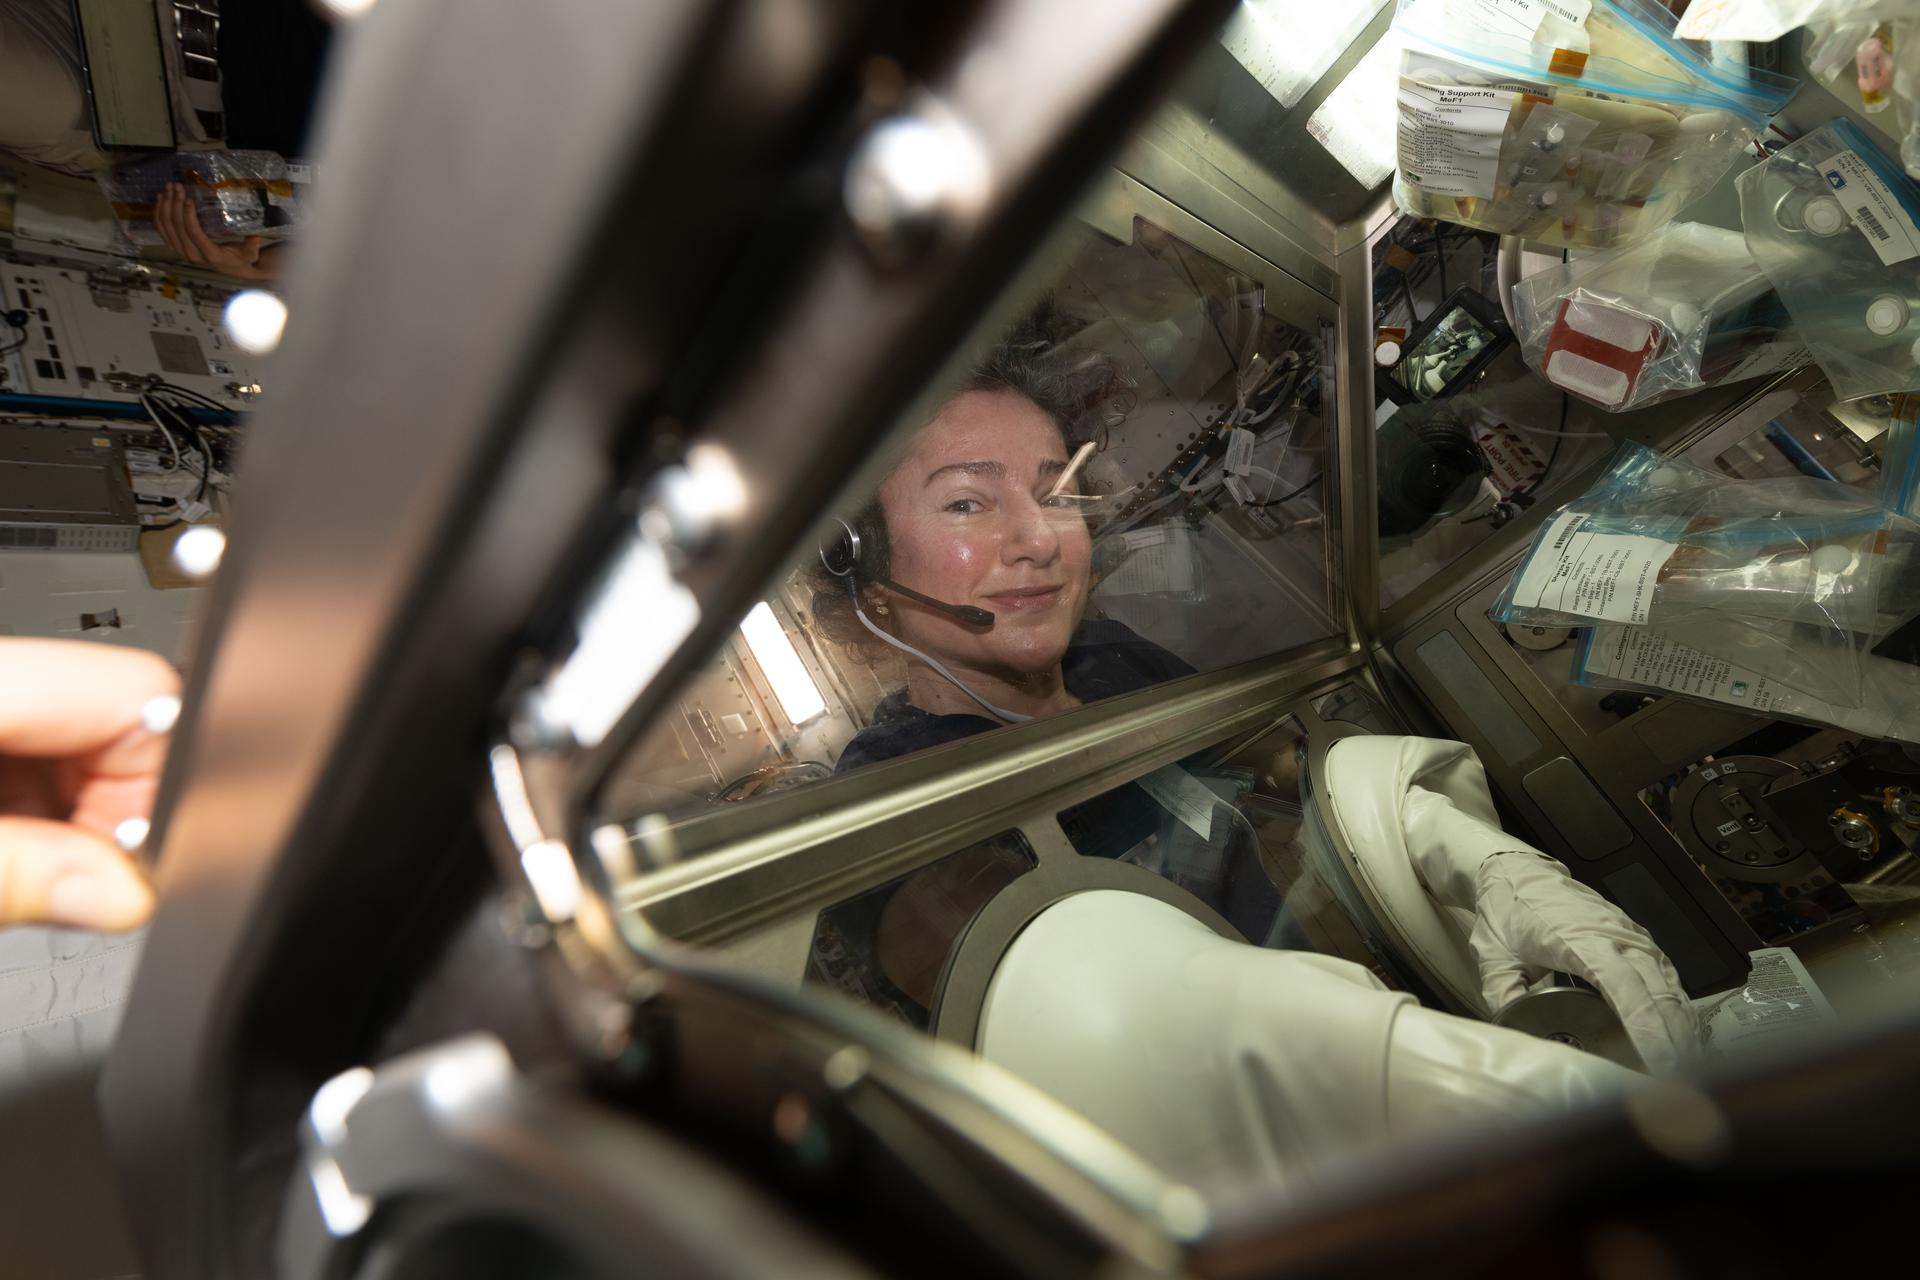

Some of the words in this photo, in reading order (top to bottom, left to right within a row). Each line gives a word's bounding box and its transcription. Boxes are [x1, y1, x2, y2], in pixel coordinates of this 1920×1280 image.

[1447, 89, 1481, 98] Support
[1482, 90, 1496, 98] Kit
[1485, 443, 1506, 465] PORT
[1504, 463, 1522, 482] FIRE
[1552, 564, 1565, 583] Sharps
[1561, 561, 1572, 577] MeF1
[1615, 624, 1630, 660] Contingency
[1720, 822, 1738, 833] Vent
